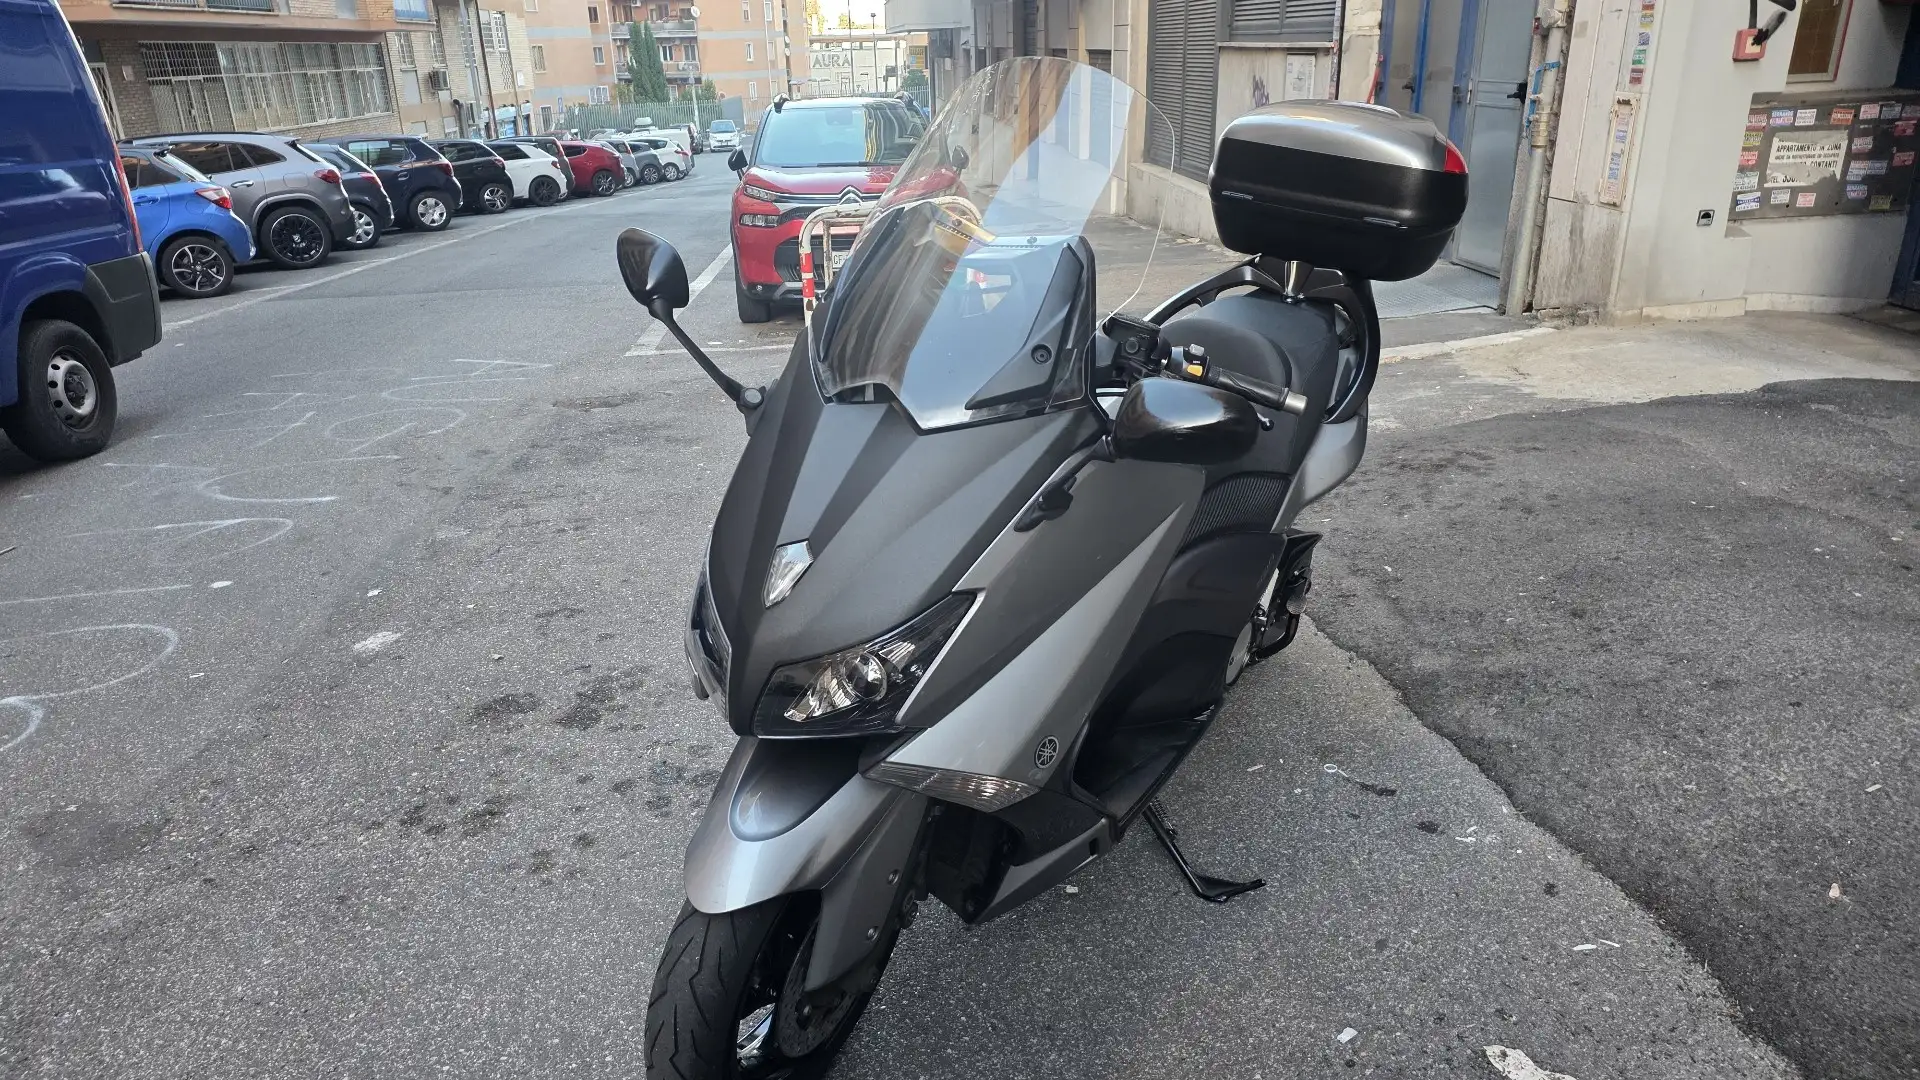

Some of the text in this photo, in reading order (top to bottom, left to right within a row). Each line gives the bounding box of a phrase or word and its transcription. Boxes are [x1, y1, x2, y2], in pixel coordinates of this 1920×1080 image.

[813, 54, 851, 68] AURA
[1776, 144, 1817, 152] APPARTAMENTO
[1827, 143, 1841, 151] ZONA
[1810, 160, 1838, 168] CONTANTI
